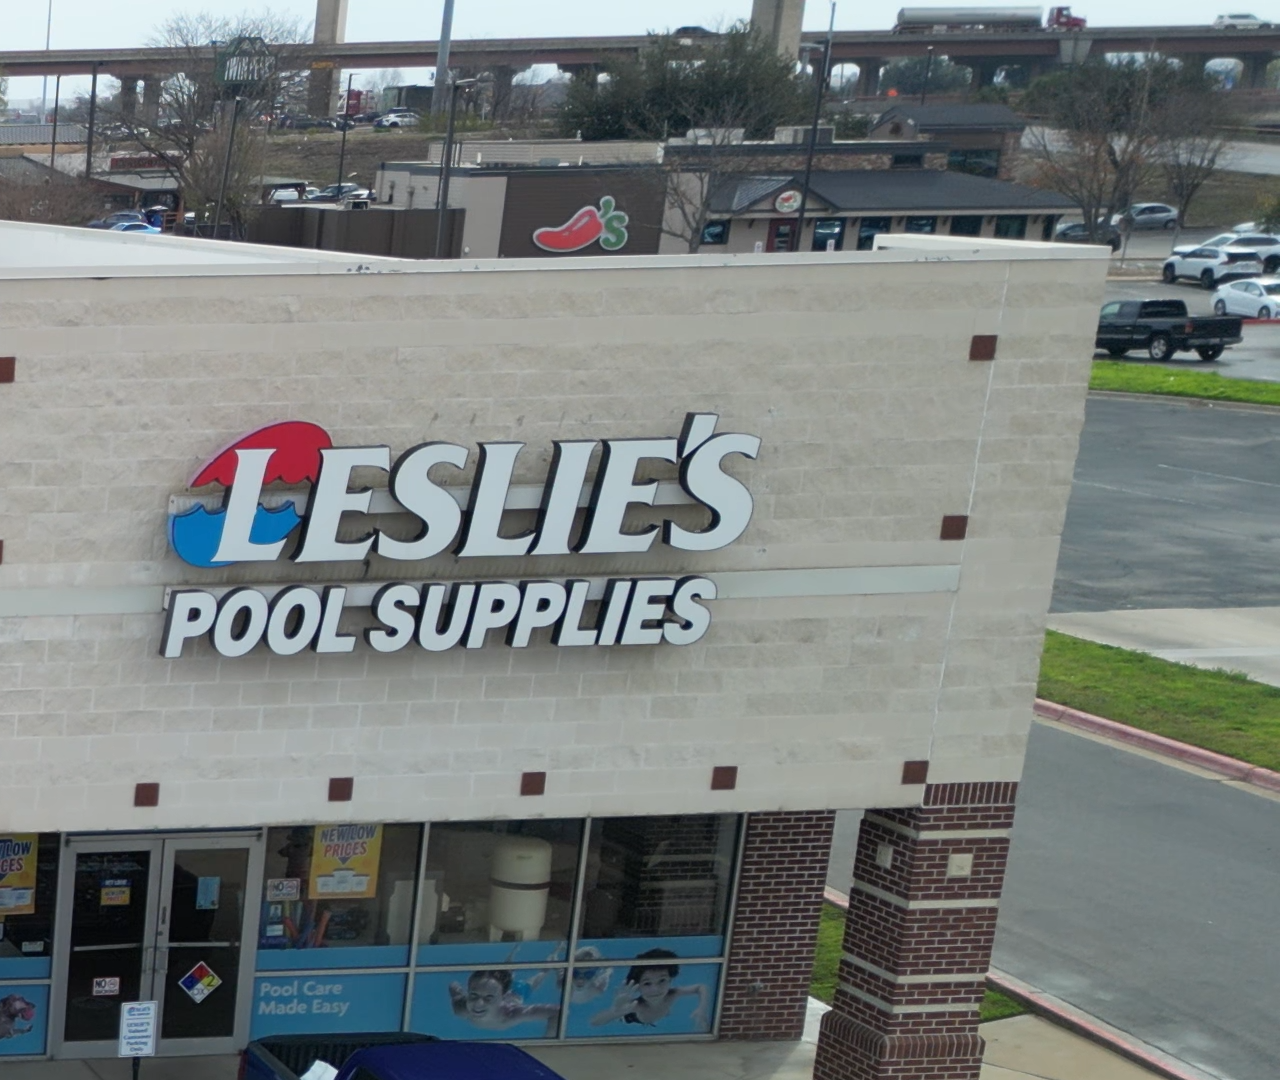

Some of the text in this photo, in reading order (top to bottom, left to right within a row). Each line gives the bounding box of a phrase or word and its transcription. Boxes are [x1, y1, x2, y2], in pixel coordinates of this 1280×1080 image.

[211, 412, 762, 563] LESLIE'S
[160, 575, 718, 659] POOL SUPPLIES
[321, 825, 378, 843] NEW LOW
[5, 841, 33, 858] LOW
[324, 842, 368, 858] PRICES
[95, 979, 107, 989] NO
[206, 974, 216, 987] 2
[260, 980, 343, 997] Pool Care
[258, 999, 350, 1018] Made Easy
